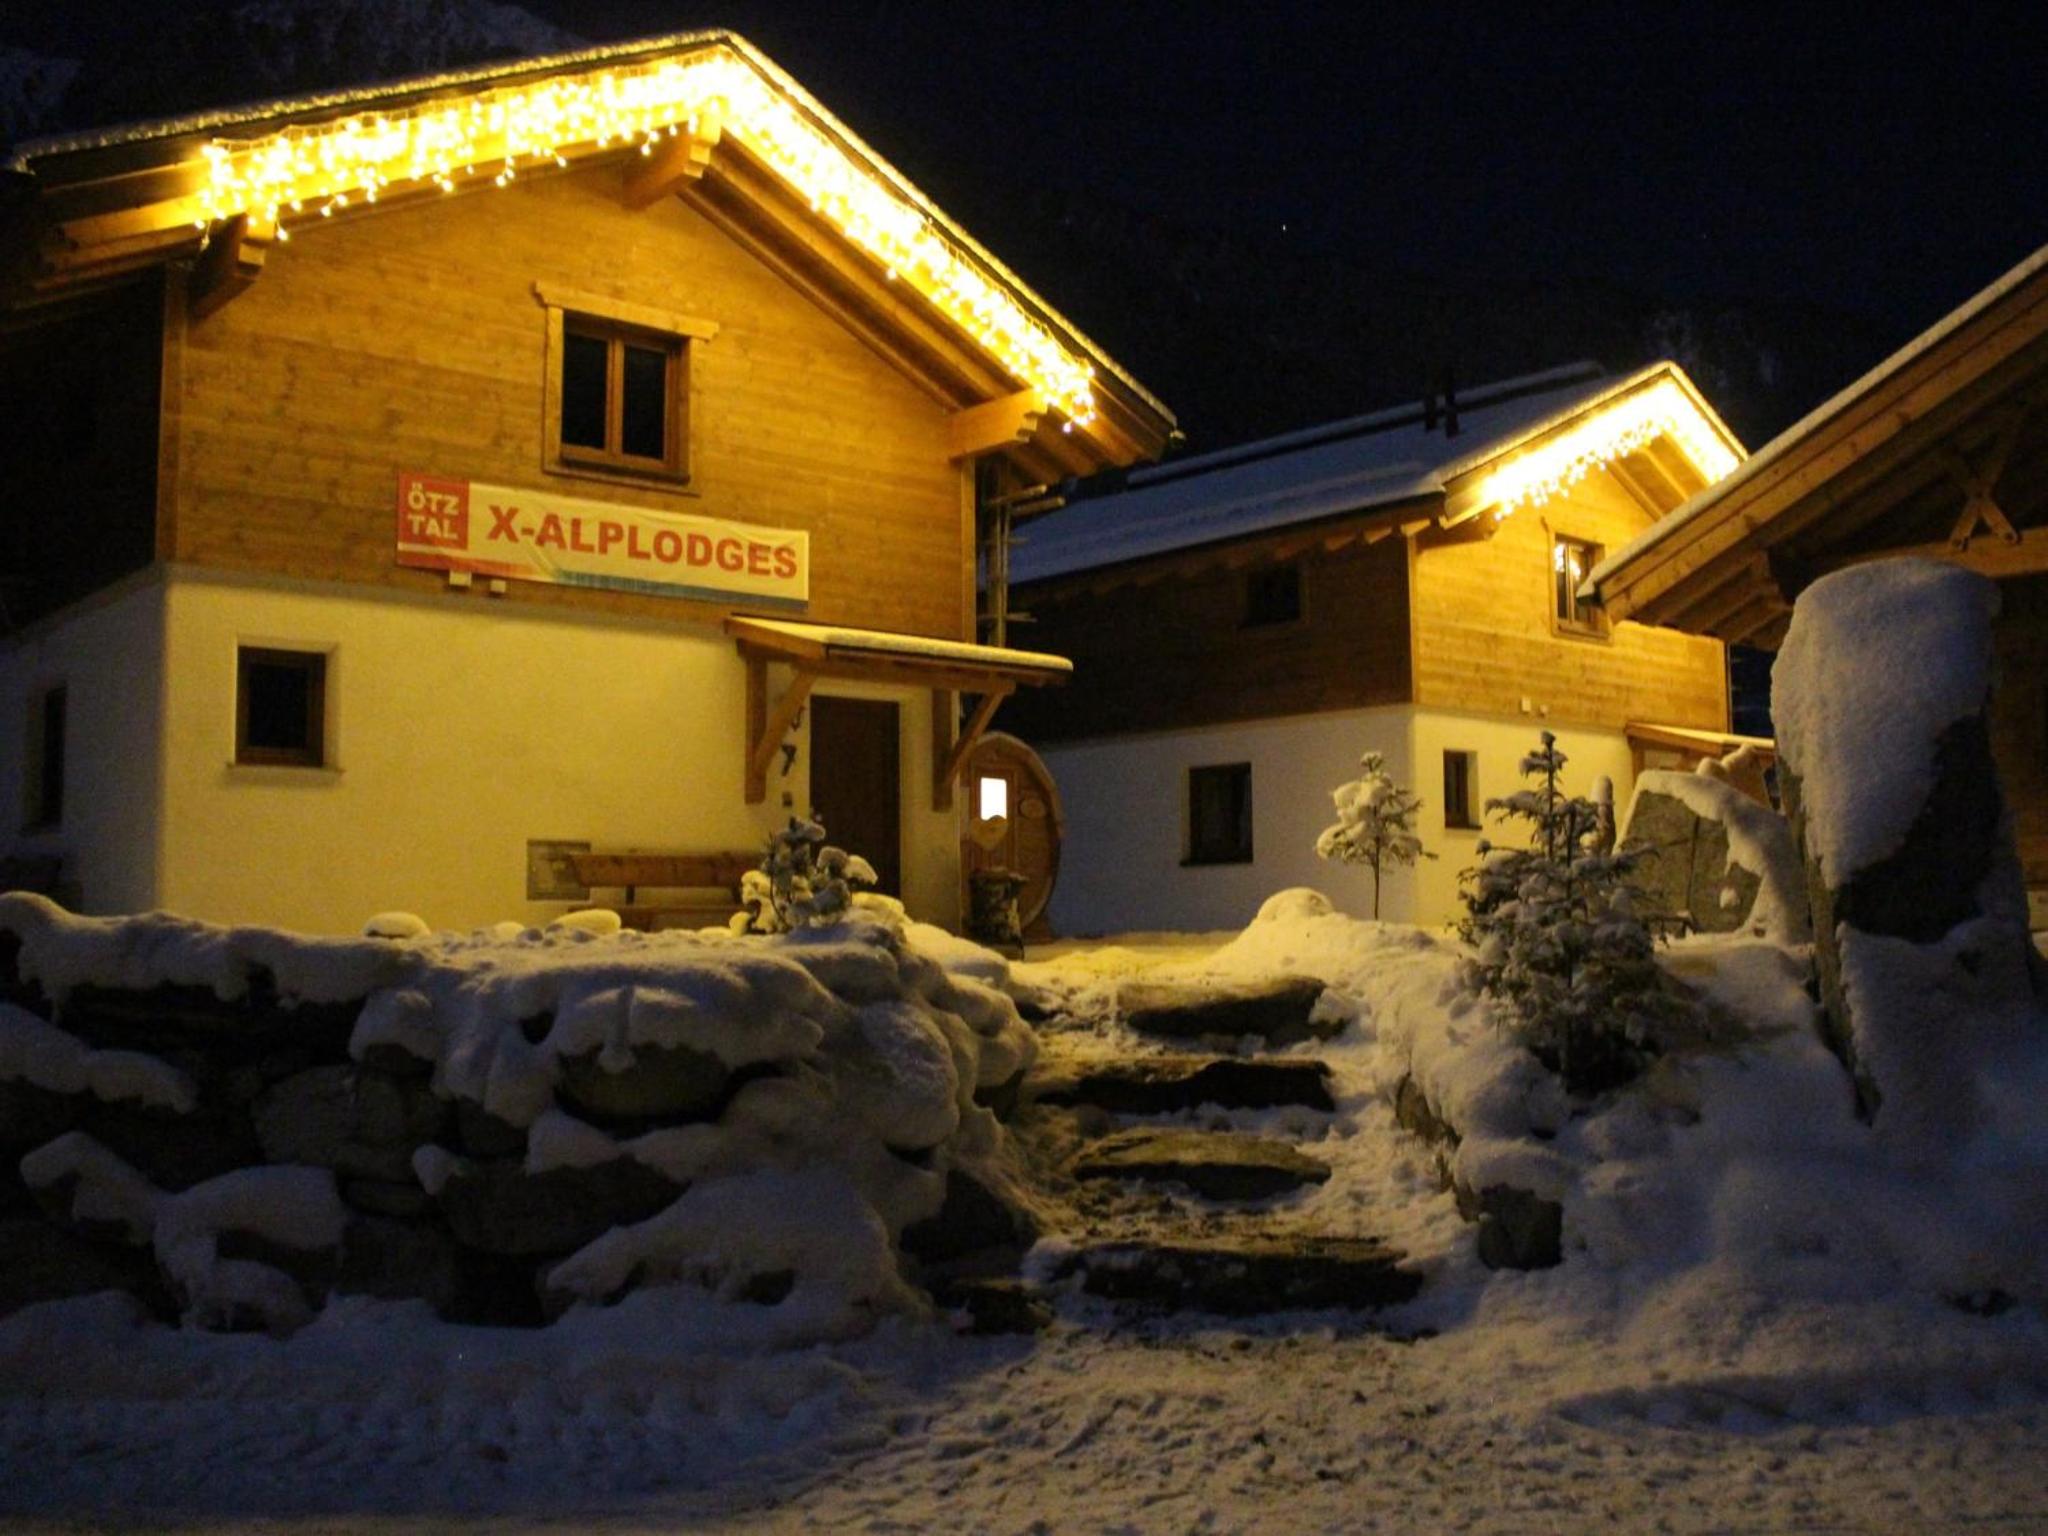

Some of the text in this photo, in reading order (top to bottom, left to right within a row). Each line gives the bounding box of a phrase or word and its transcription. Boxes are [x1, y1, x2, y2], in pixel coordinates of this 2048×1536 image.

[407, 482, 459, 515] ÖTZ
[407, 513, 459, 539] TAL
[486, 505, 798, 579] X-ALPLODGES
